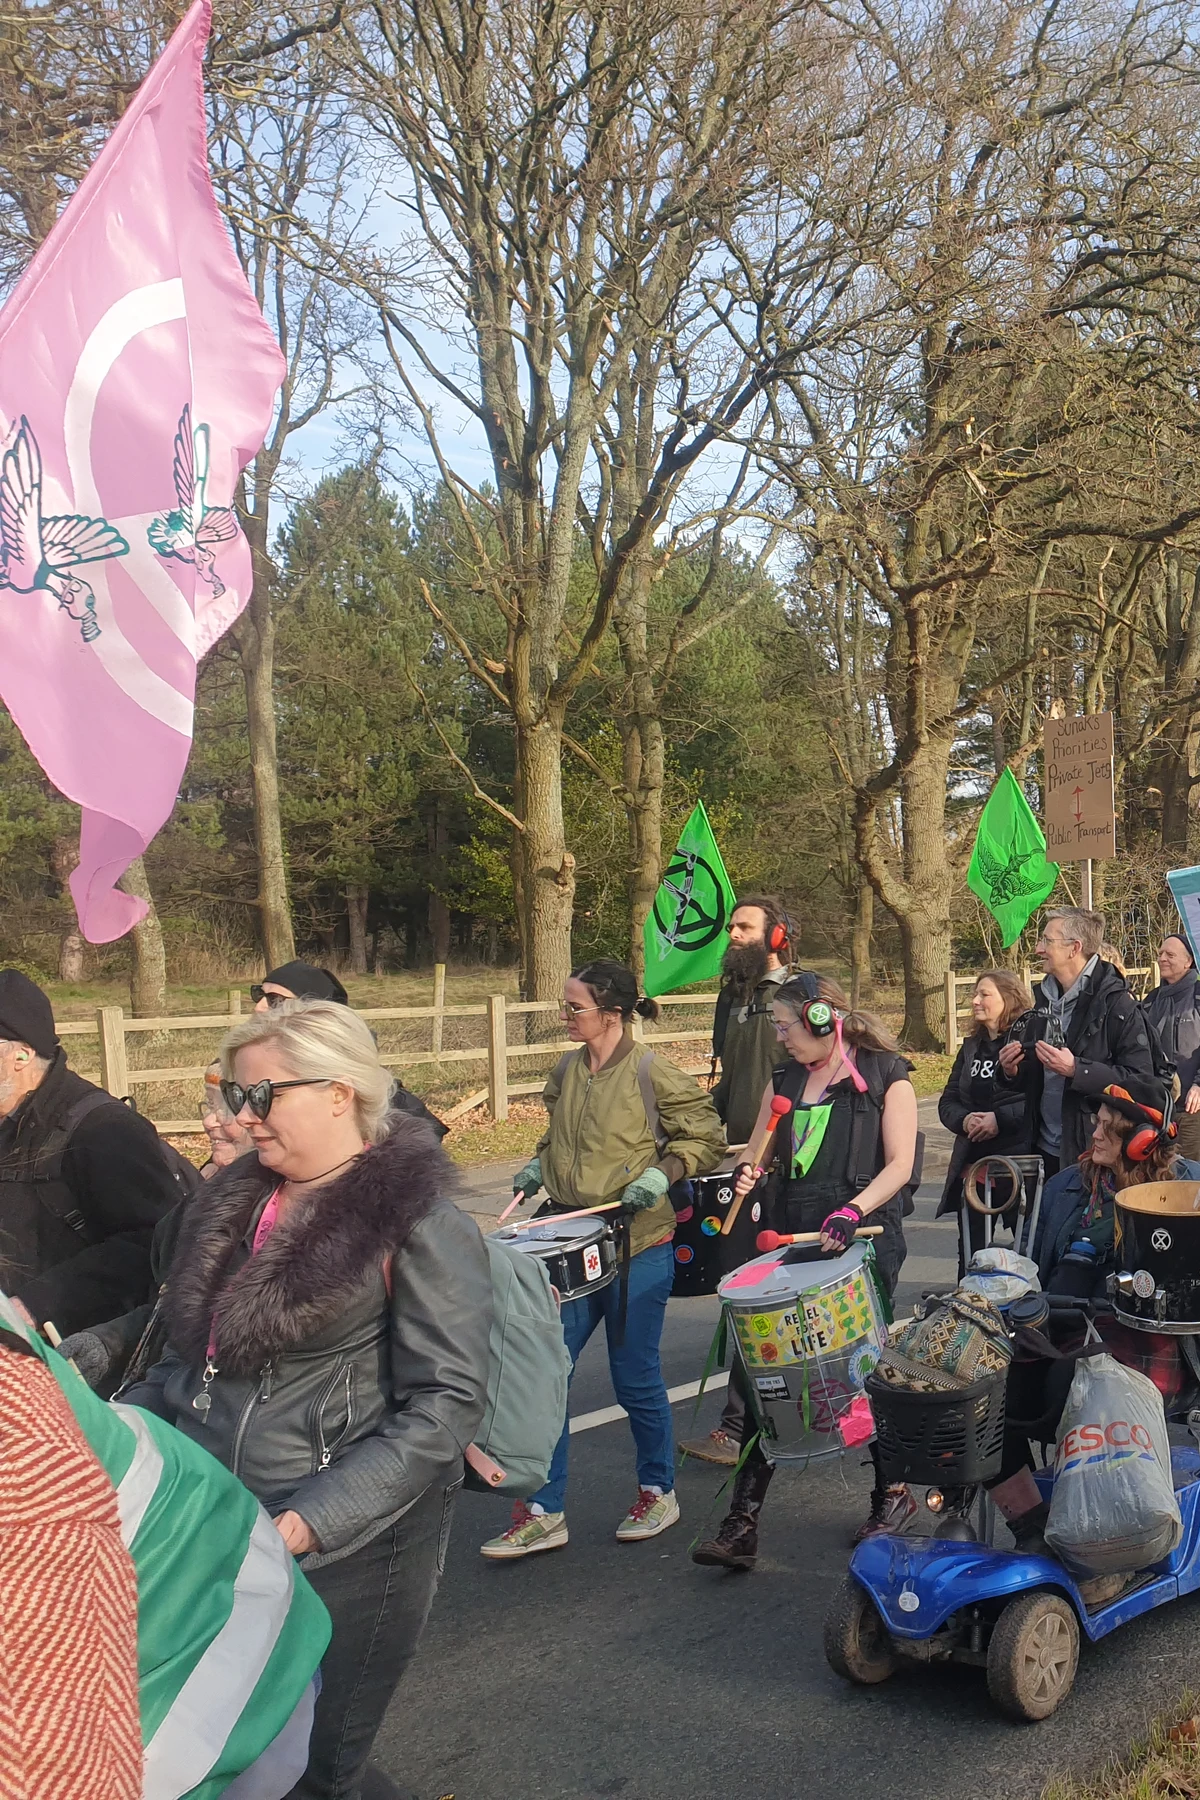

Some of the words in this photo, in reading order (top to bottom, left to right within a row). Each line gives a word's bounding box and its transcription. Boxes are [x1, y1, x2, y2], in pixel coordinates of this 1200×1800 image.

[1053, 738, 1108, 760] Priorities
[1048, 763, 1084, 793] Private
[1087, 761, 1112, 785] Jets
[1047, 822, 1073, 850] Public
[1074, 821, 1112, 843] Transport
[784, 1306, 820, 1327] REEL
